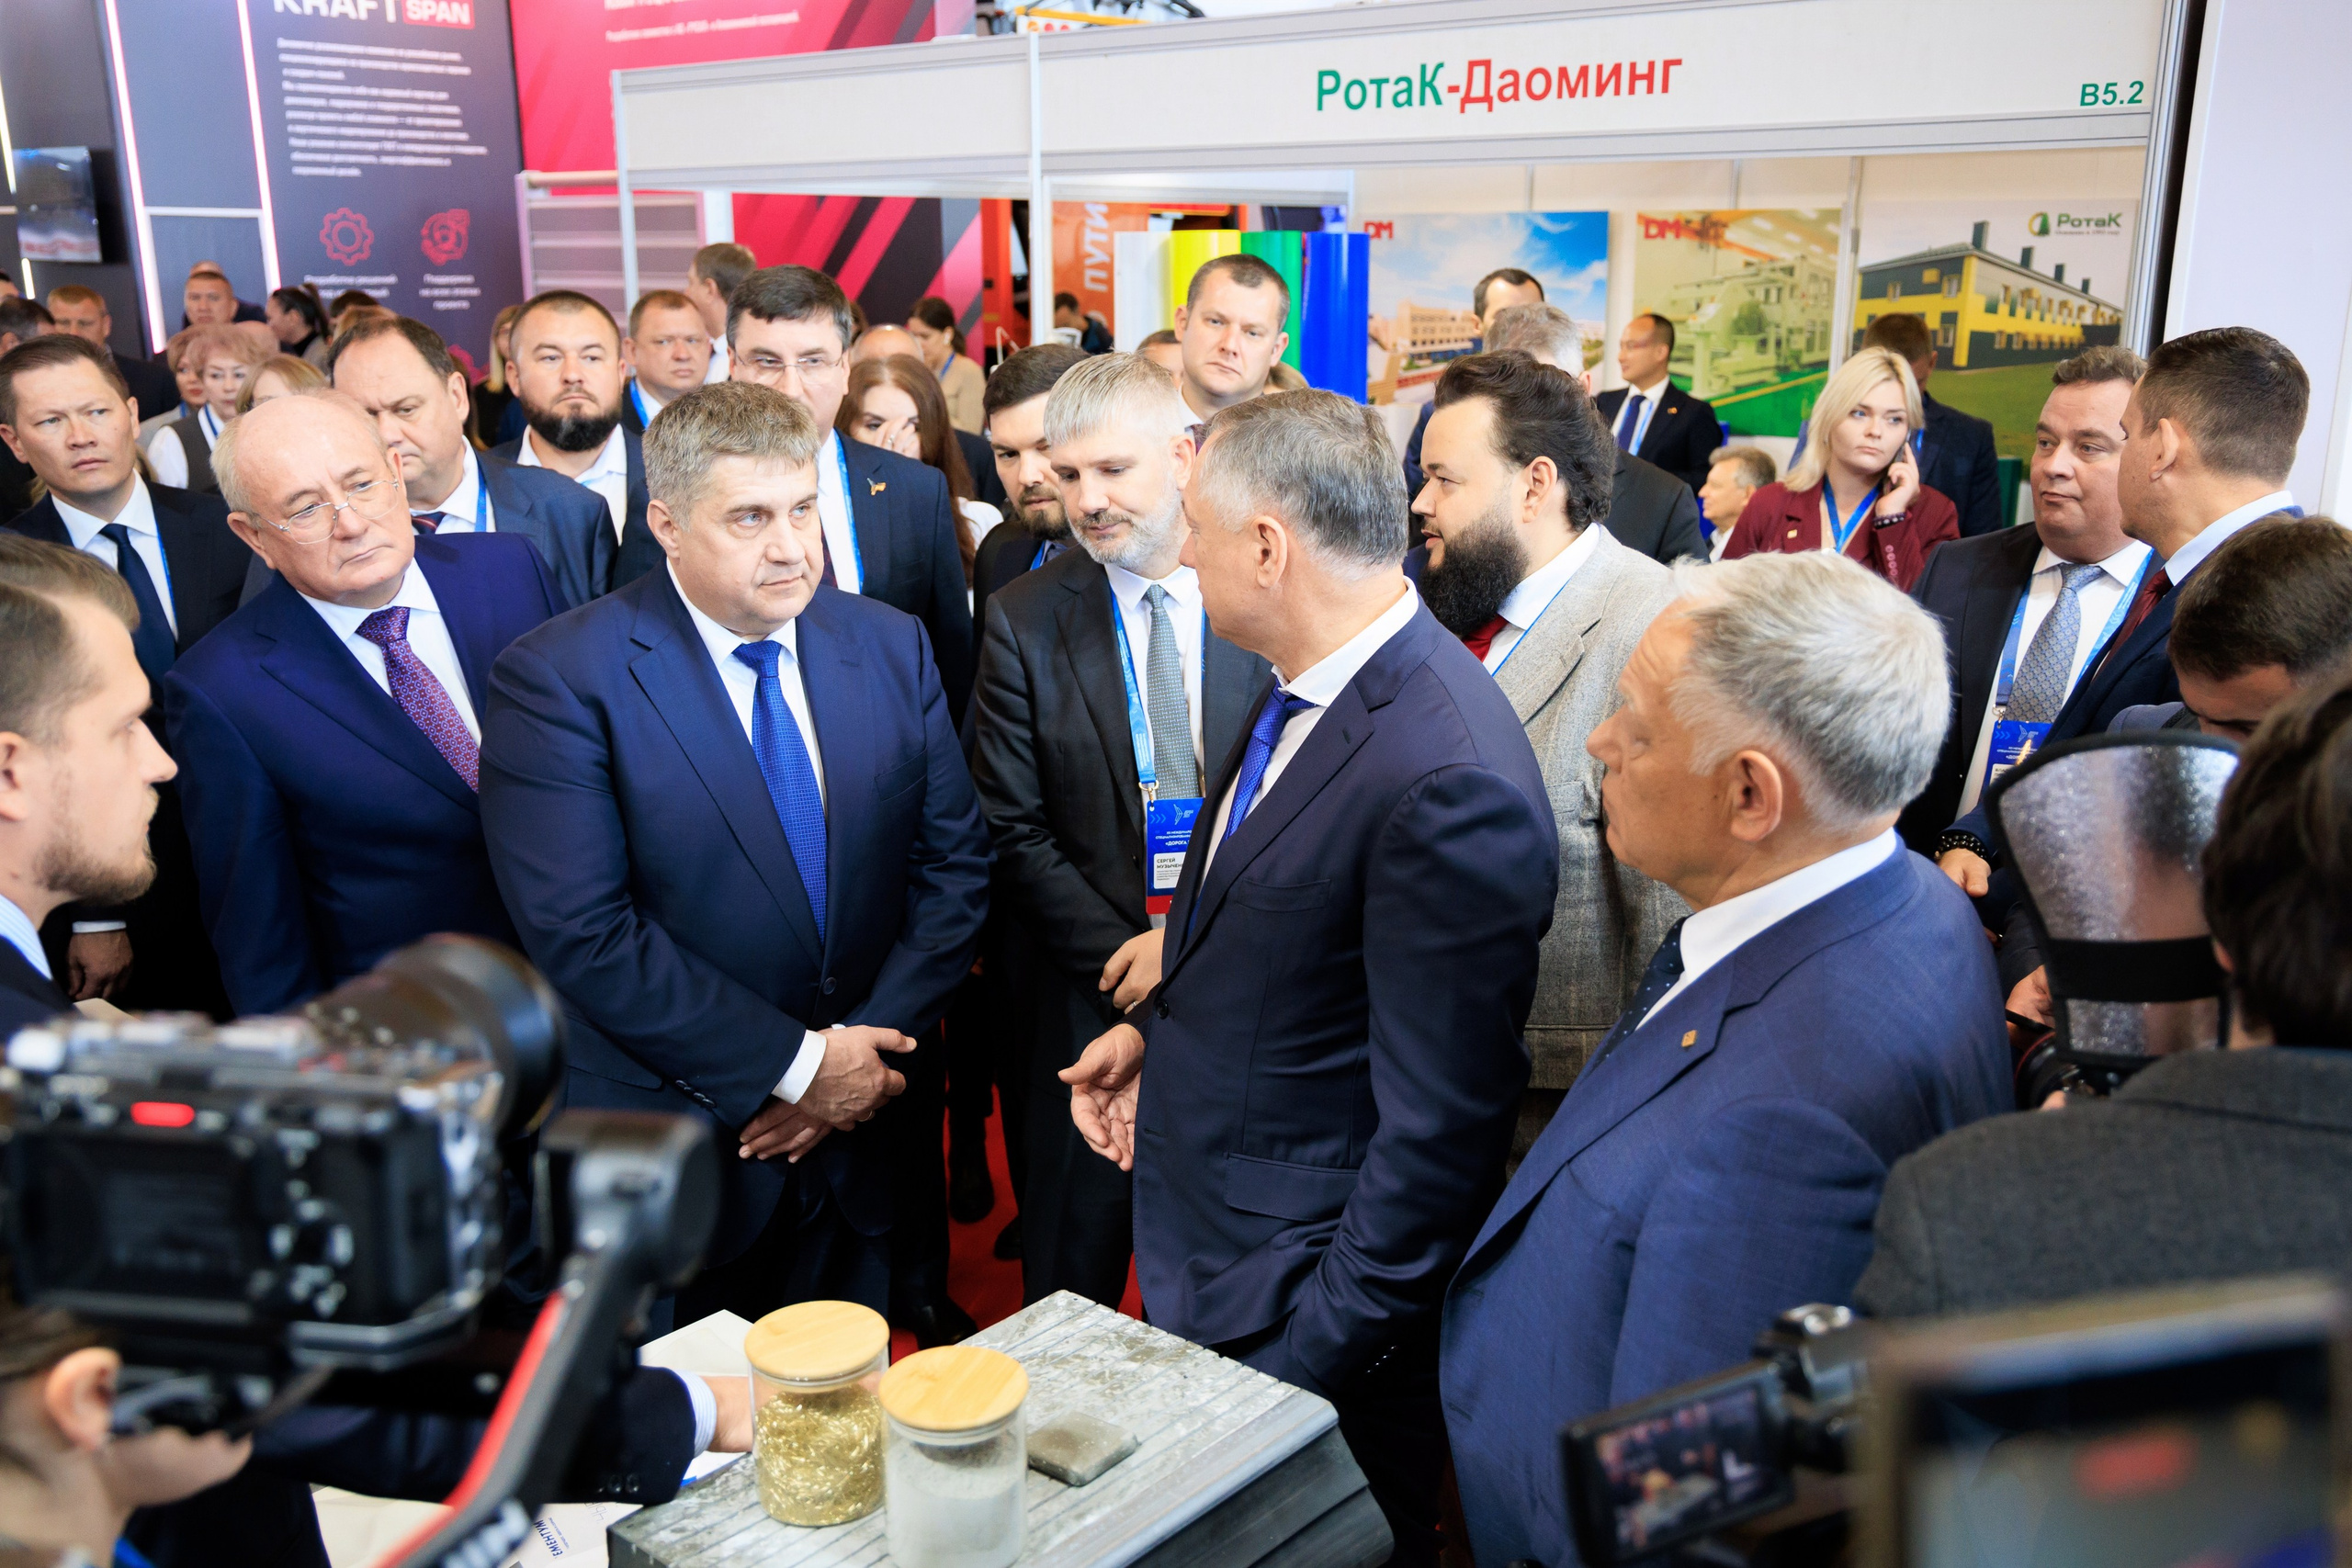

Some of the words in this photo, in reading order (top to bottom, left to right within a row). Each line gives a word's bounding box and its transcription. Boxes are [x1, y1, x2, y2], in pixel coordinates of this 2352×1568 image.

[405, 0, 471, 25] SPAN
[1317, 58, 1683, 114] РотаК-Даоминг
[1364, 220, 1393, 240] DM
[1644, 218, 1680, 239] DM
[2057, 212, 2122, 228] РотаК
[534, 1519, 563, 1559] ЕМЕНТУМ
